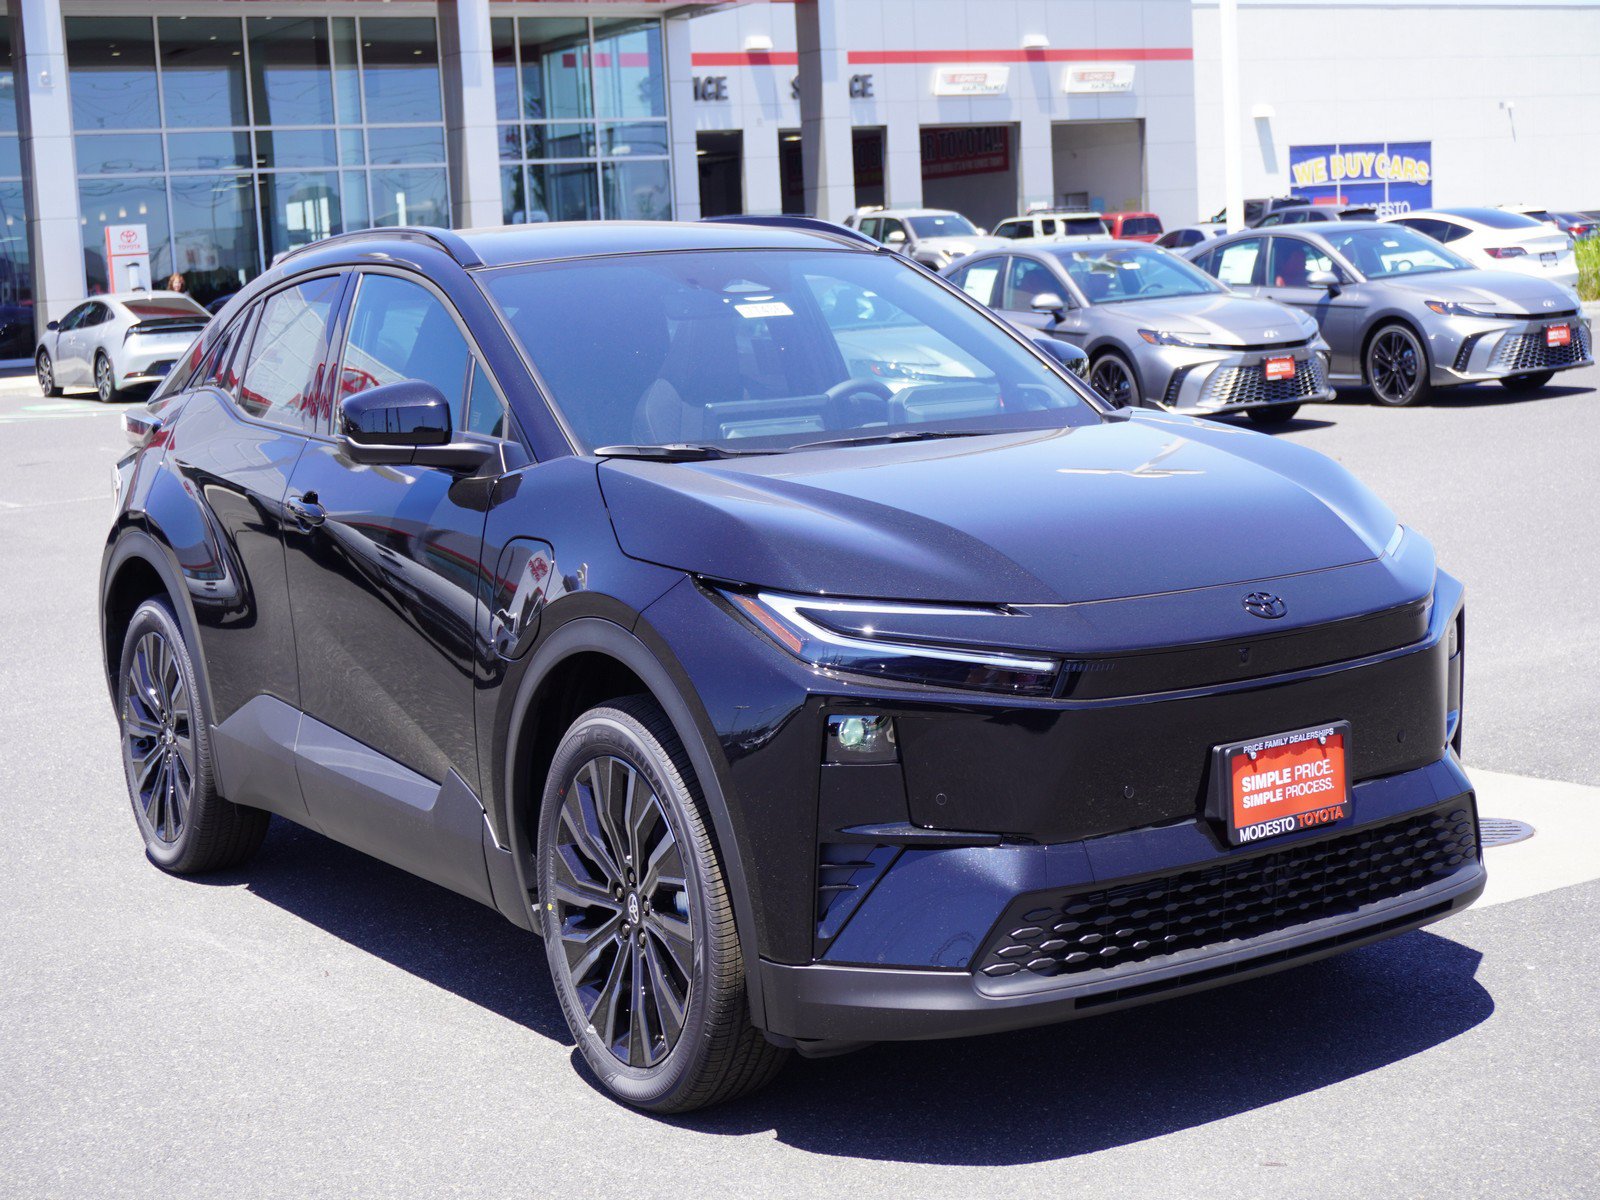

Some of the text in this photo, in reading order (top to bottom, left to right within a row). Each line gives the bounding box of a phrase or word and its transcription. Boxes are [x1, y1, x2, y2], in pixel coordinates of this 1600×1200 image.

[1292, 151, 1430, 188] WE BUY CARS
[1243, 727, 1334, 754] PRICE FAMILY DEALERSHIPS
[1241, 758, 1334, 793] SIMPLE PRICE.
[1242, 777, 1335, 809] SIMPLE PROCESS.
[1239, 805, 1344, 843] MODESTO TOYOTA
[553, 971, 591, 1059] YOKOHAMA
